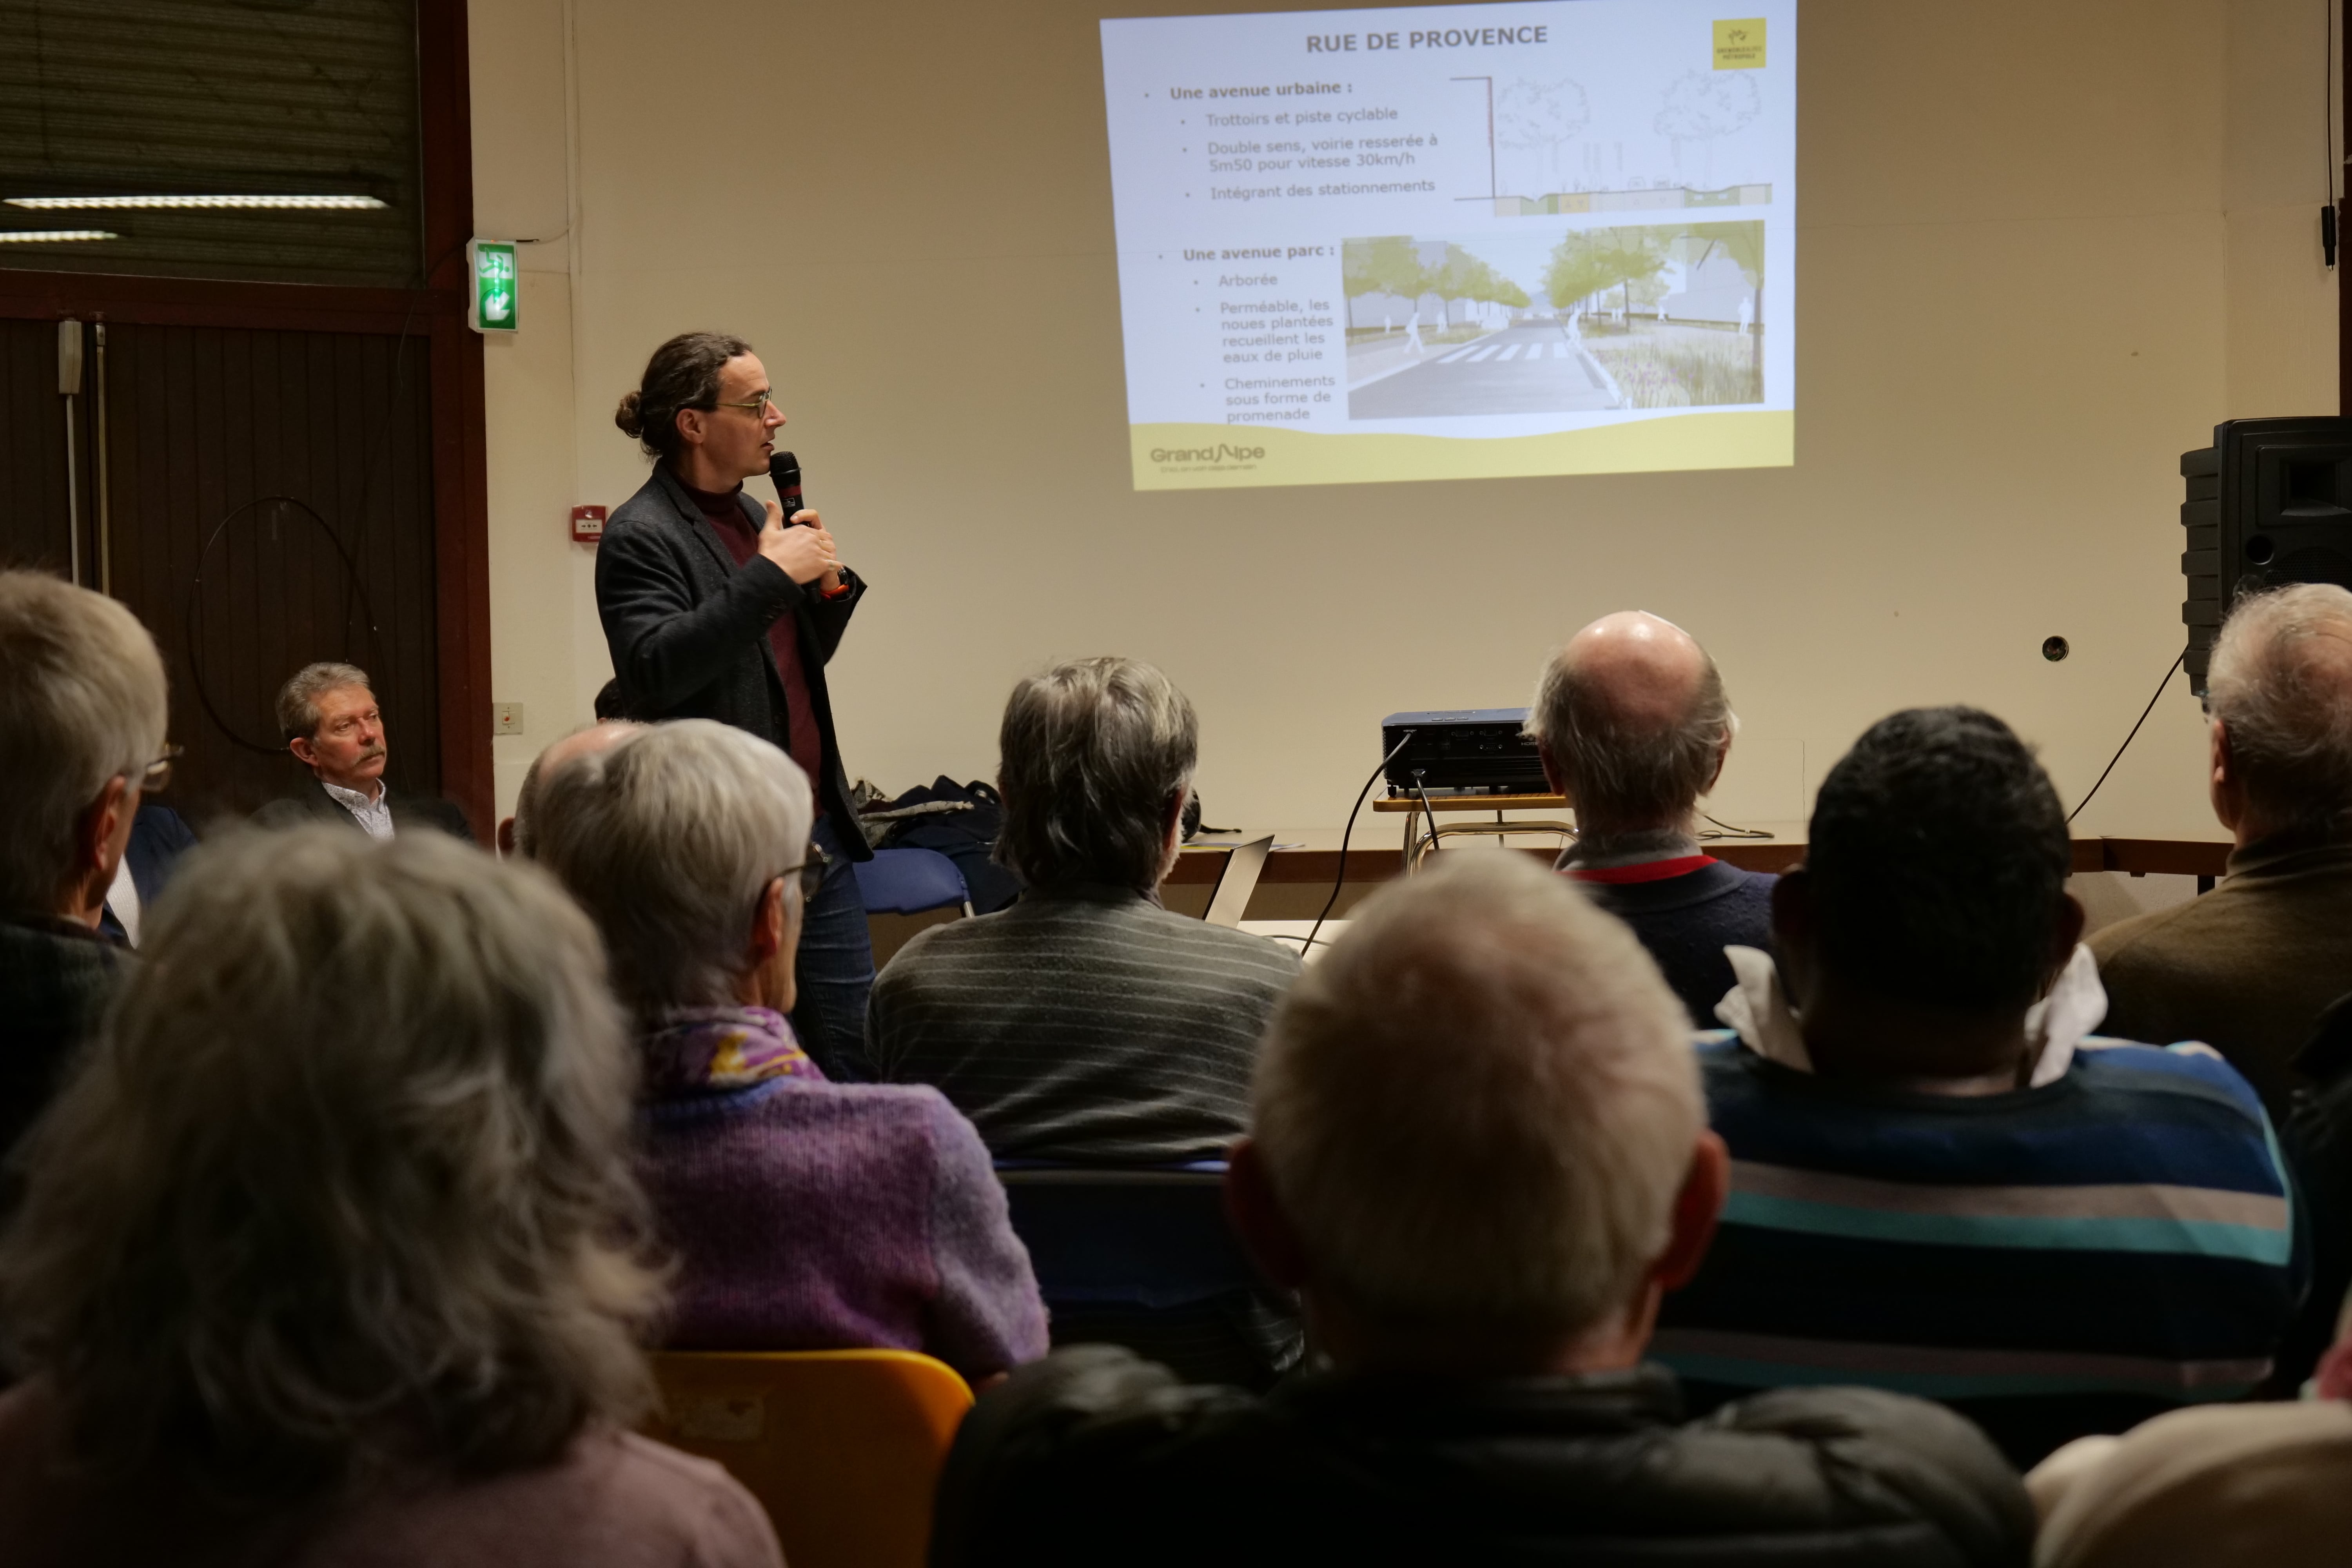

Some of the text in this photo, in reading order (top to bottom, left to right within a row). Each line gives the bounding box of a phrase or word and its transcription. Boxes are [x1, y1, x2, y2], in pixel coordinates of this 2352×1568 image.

[1307, 25, 1547, 53] RUE DE PROVENCE
[1170, 87, 1203, 100] Une
[1209, 86, 1270, 98] avenue
[1276, 82, 1341, 96] urbaine
[1205, 107, 1398, 127] Trottoirs et piste cyclable
[1207, 133, 1438, 155] Double sens, voirie resserée à
[1209, 151, 1415, 172] 5m50 pour vitesse 30km/h
[1210, 180, 1436, 202] Intégrant des stationnements
[1183, 249, 1216, 261] Une
[1221, 248, 1282, 260] avenue
[1287, 246, 1324, 260] parc
[1218, 274, 1278, 287] Arborée
[1220, 299, 1330, 314] Perméable, les
[1221, 315, 1334, 331] noues plantées
[1222, 332, 1325, 347] recueillent les
[1223, 348, 1323, 363] eaux de pluie
[1224, 376, 1336, 390] Cheminements
[1225, 390, 1331, 407] sous forme de
[1227, 408, 1310, 425] promenade
